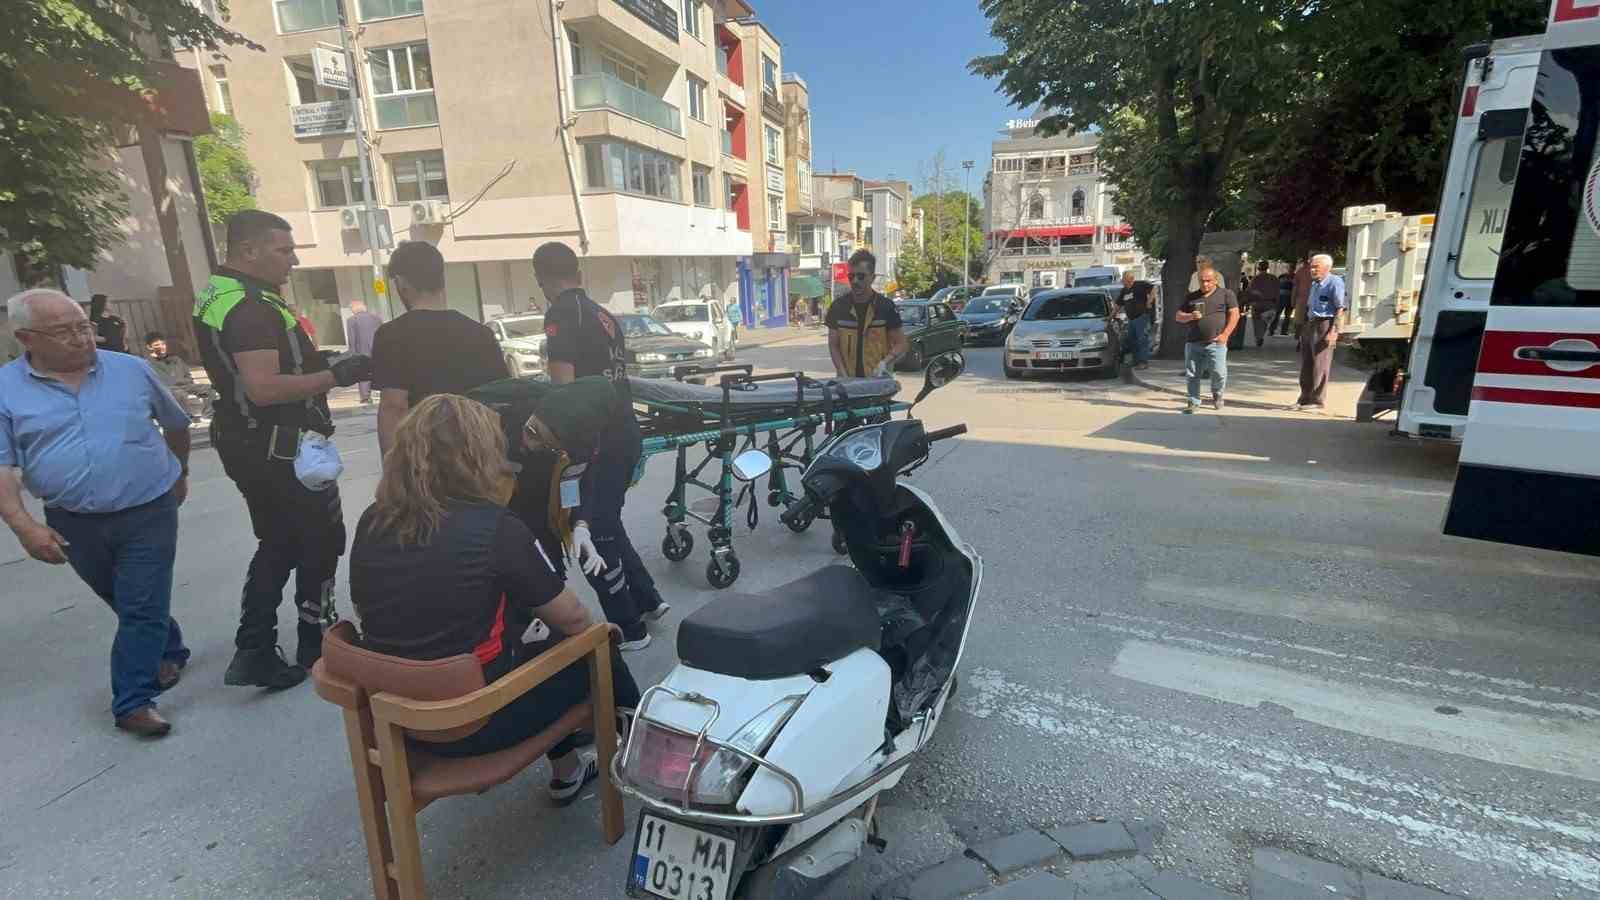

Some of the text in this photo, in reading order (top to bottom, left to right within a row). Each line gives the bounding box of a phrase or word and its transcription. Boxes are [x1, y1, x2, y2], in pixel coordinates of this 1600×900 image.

[645, 820, 728, 874] 11 MA
[653, 860, 714, 900] 0313
